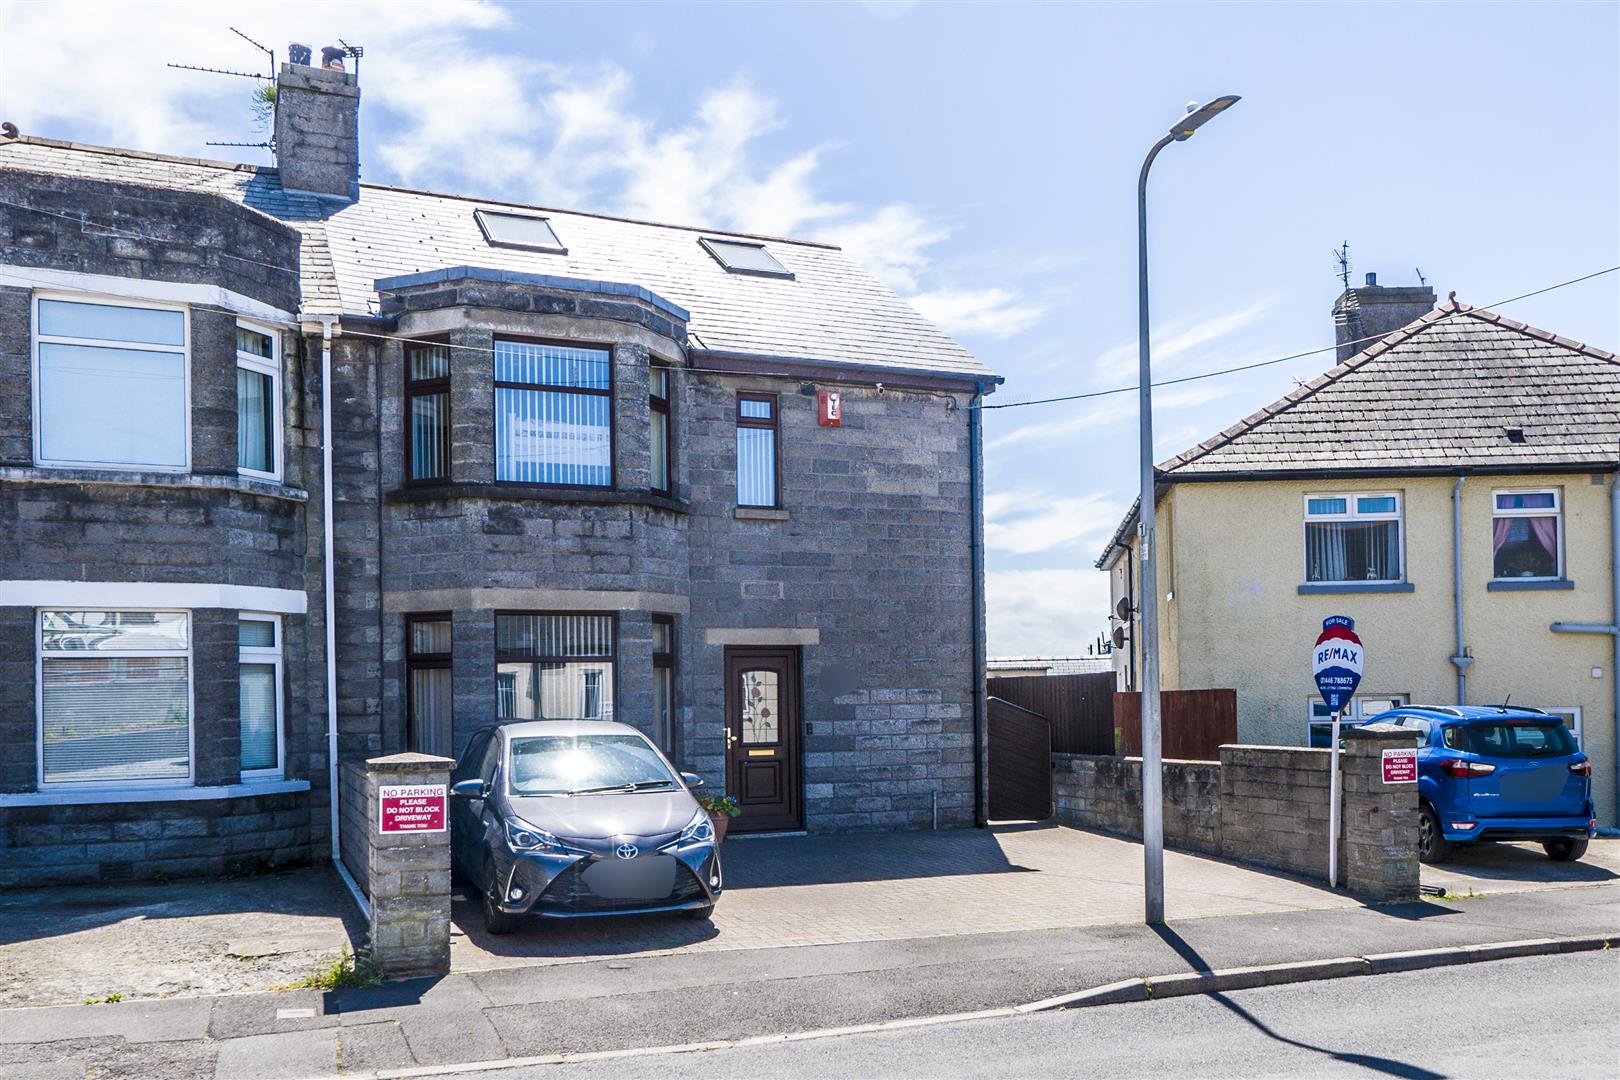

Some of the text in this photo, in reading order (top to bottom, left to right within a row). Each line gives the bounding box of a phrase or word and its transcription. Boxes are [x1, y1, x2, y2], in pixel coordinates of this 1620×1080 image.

[1325, 617, 1348, 626] FOR SALE
[1318, 647, 1358, 665] RE/MAX
[383, 788, 444, 797] NO PARKING
[394, 814, 432, 822] DRIVEWAY
